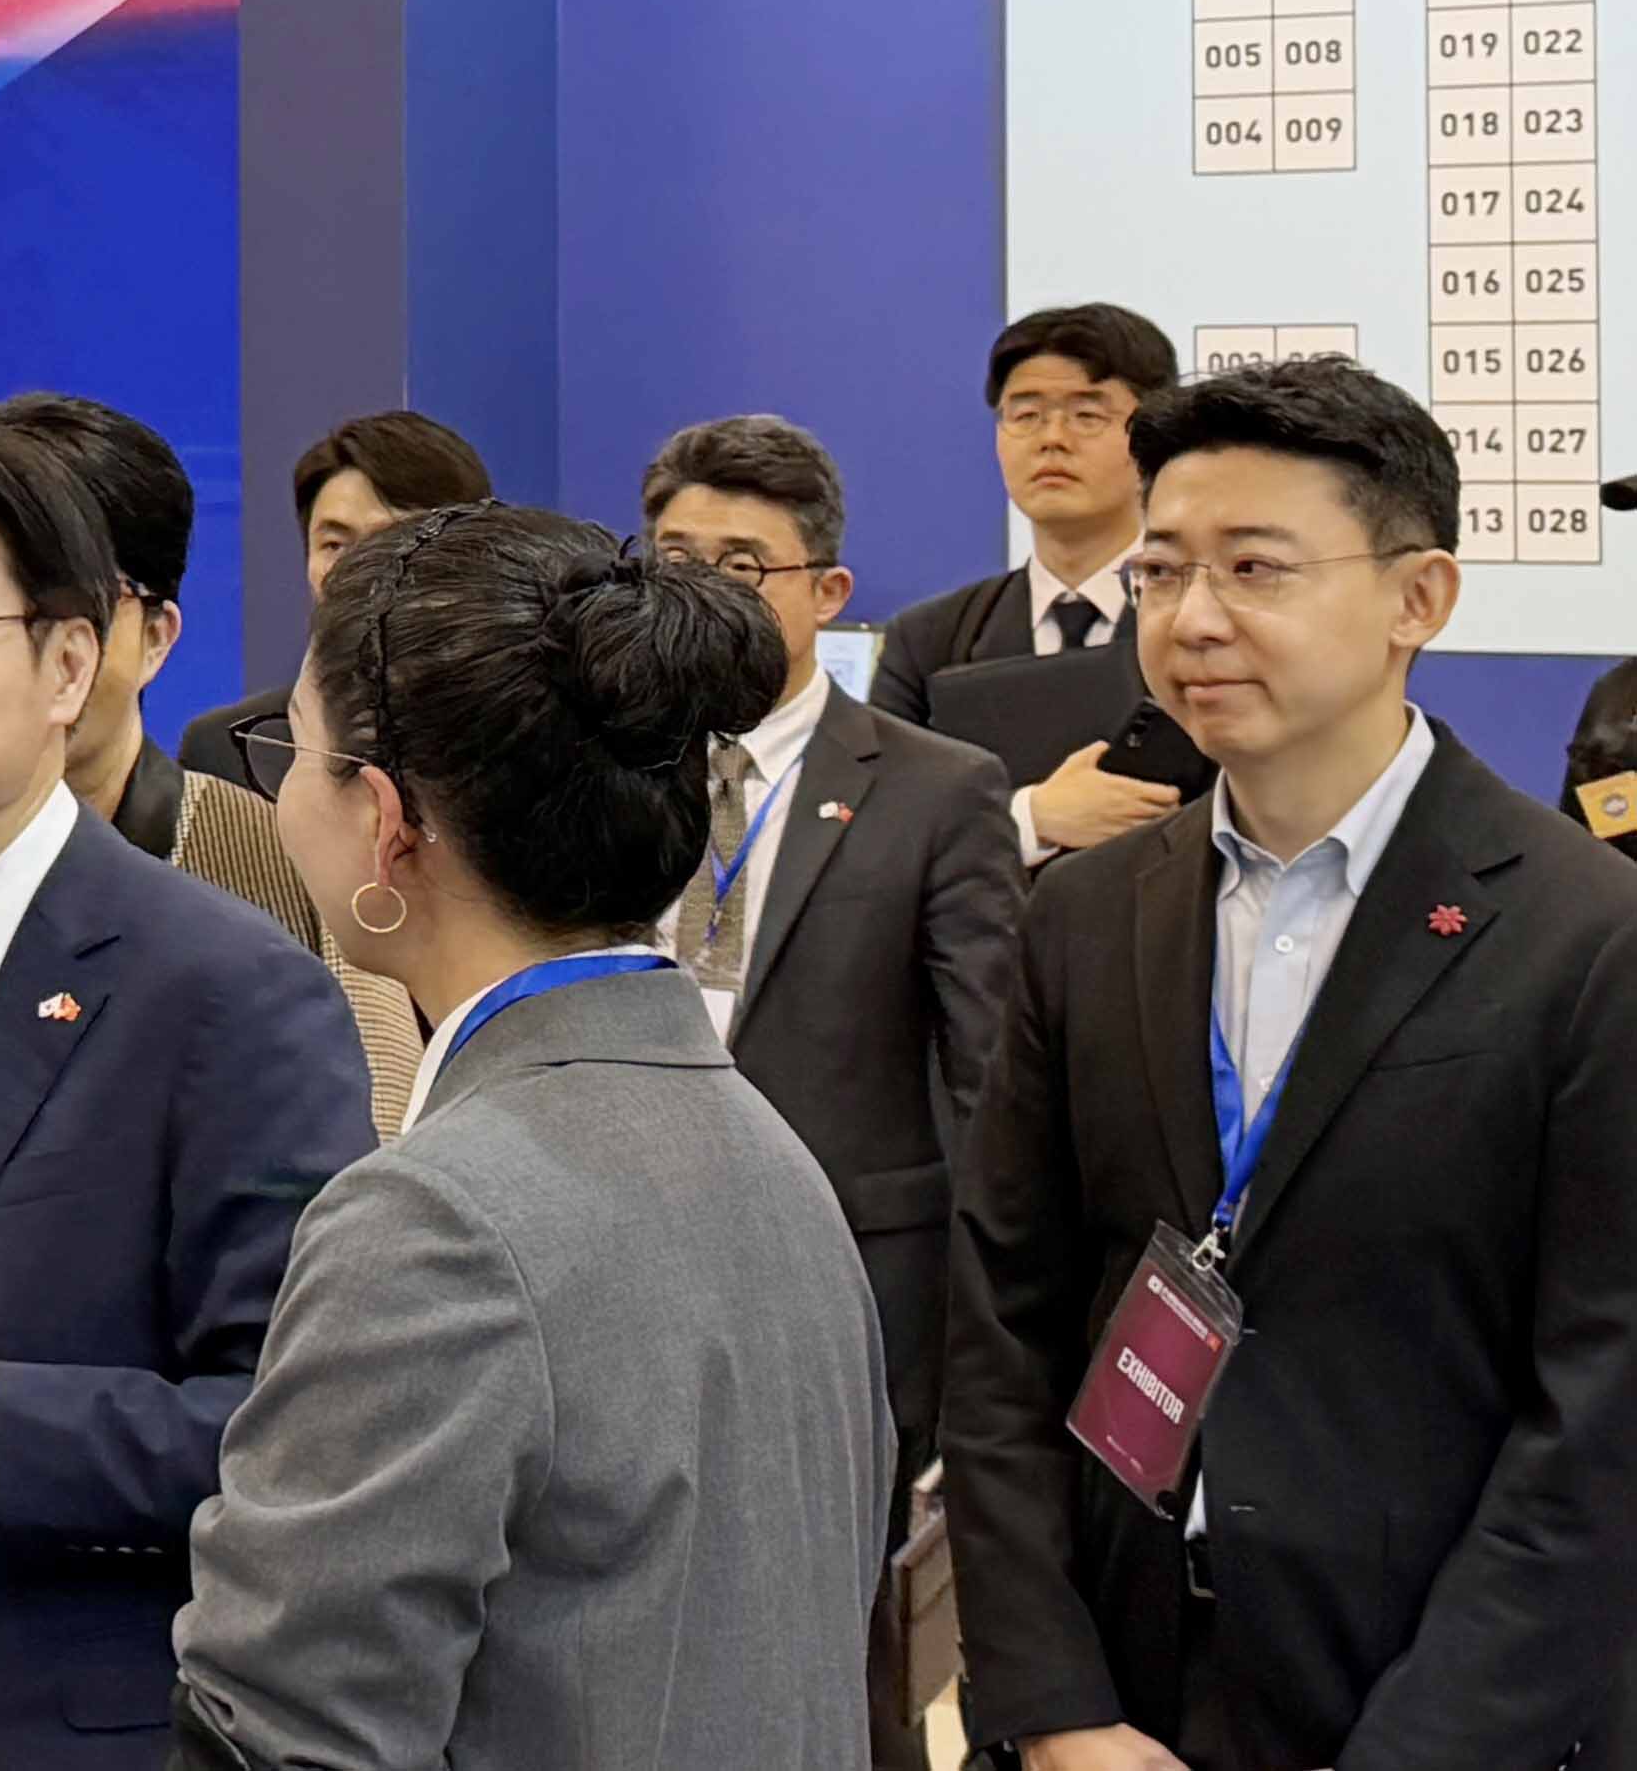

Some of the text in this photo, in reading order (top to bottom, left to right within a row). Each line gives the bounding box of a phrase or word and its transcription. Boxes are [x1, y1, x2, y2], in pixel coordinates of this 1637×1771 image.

[1205, 39, 1342, 69] 005 008
[1440, 28, 1583, 59] 019 022
[1206, 117, 1342, 146] 004 009
[1440, 108, 1584, 137] 018 023
[1441, 188, 1584, 216] 017 024
[1442, 268, 1585, 296] 016 025
[1443, 348, 1586, 374] 015 026
[1527, 428, 1587, 454] 027
[1467, 508, 1587, 534] 13 028
[1117, 1346, 1185, 1424] EXHIBITOR
